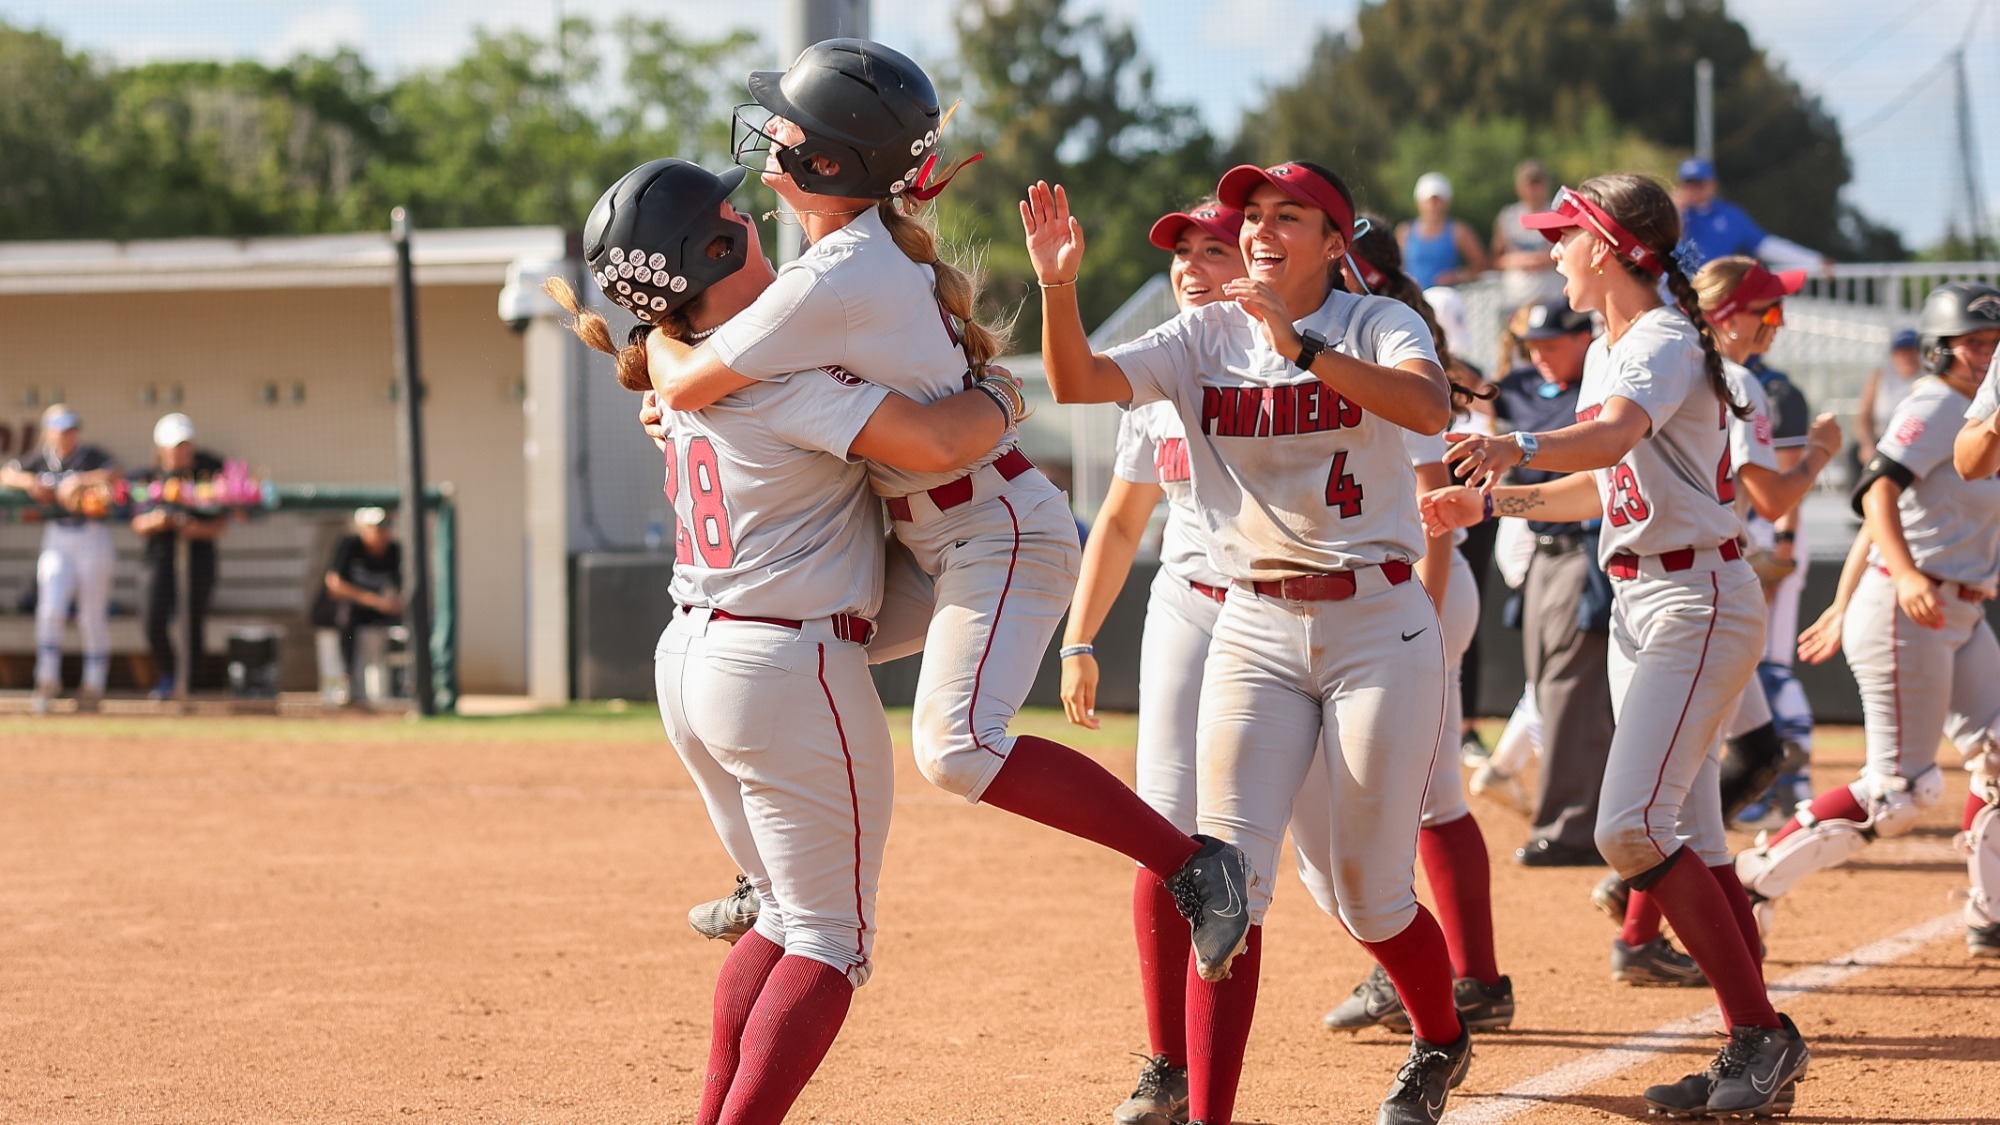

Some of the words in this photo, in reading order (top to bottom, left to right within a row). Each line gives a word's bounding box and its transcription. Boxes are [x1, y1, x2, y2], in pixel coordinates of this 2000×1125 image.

[1201, 380, 1363, 438] PANTHERS
[1325, 450, 1363, 519] 4
[1607, 462, 1649, 528] 23
